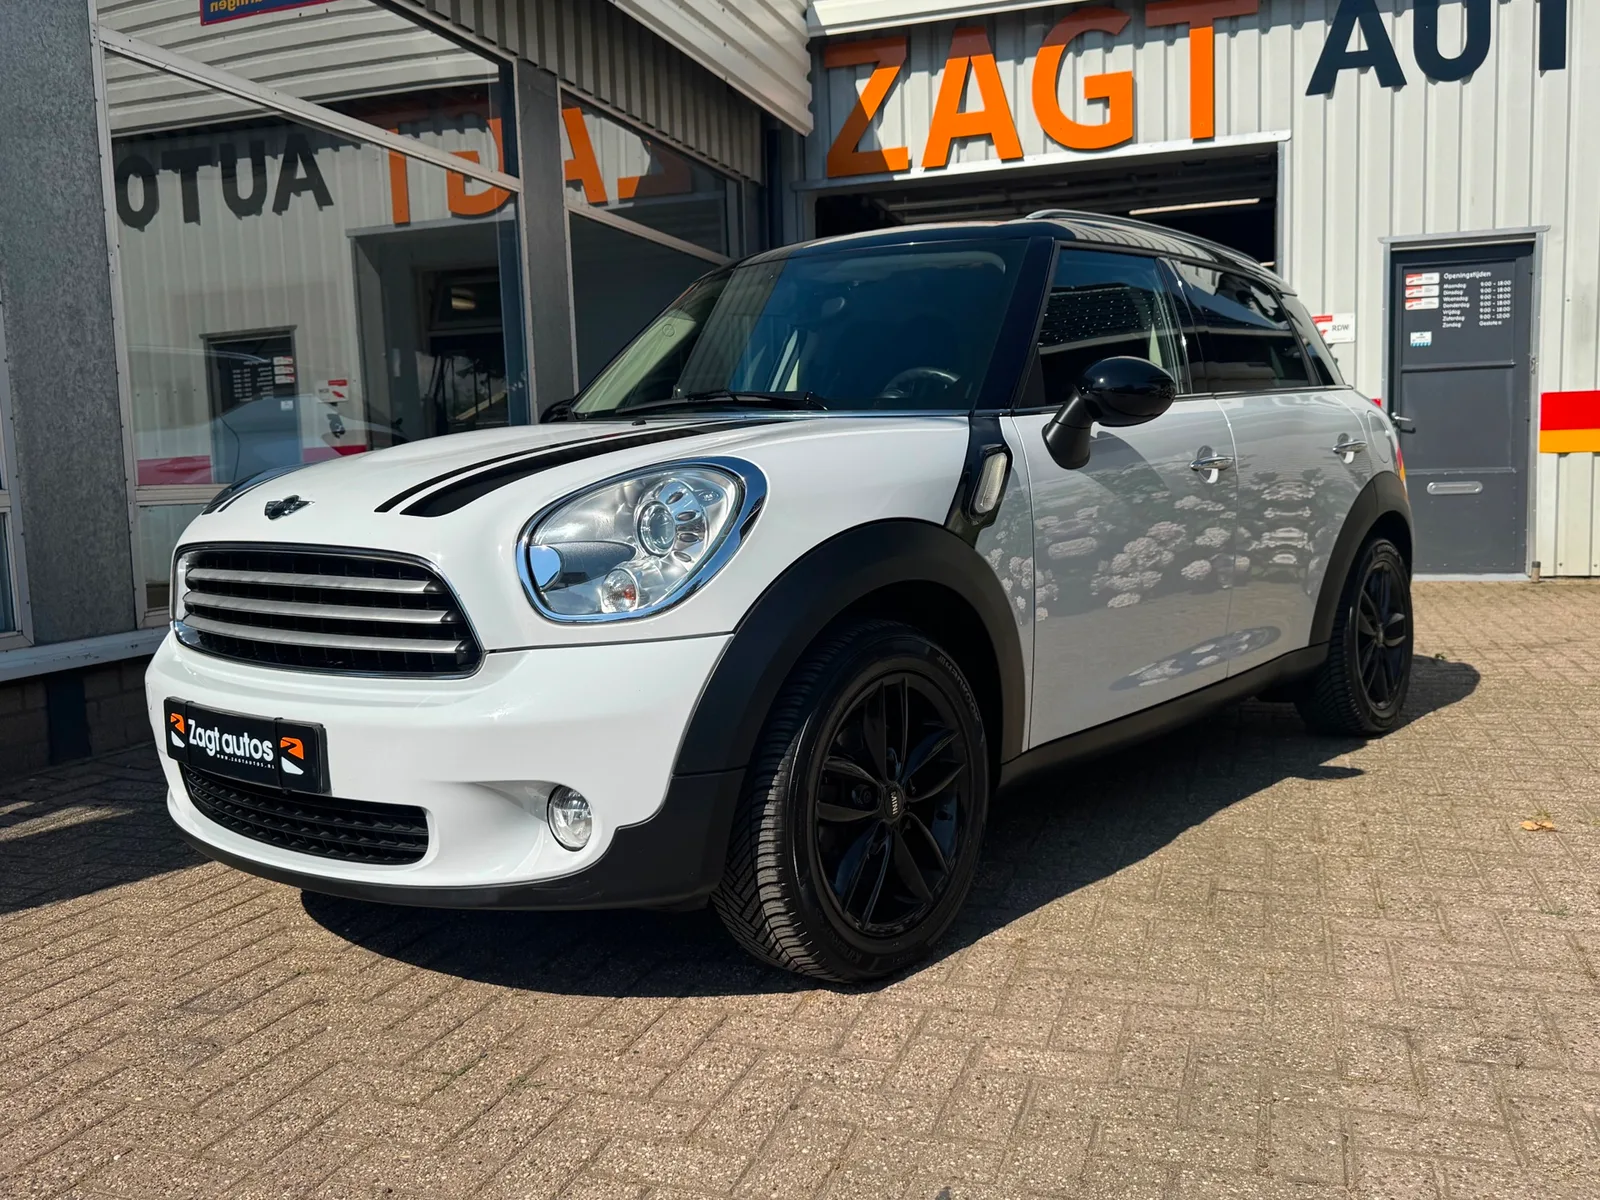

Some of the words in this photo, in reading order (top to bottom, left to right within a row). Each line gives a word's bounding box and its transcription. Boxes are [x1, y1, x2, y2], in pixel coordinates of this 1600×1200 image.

[823, 0, 1258, 177] ZAGT
[1443, 271, 1492, 280] Openingstijden
[188, 718, 220, 757] Zagt
[222, 732, 274, 762] autos
[890, 790, 899, 815] MINI
